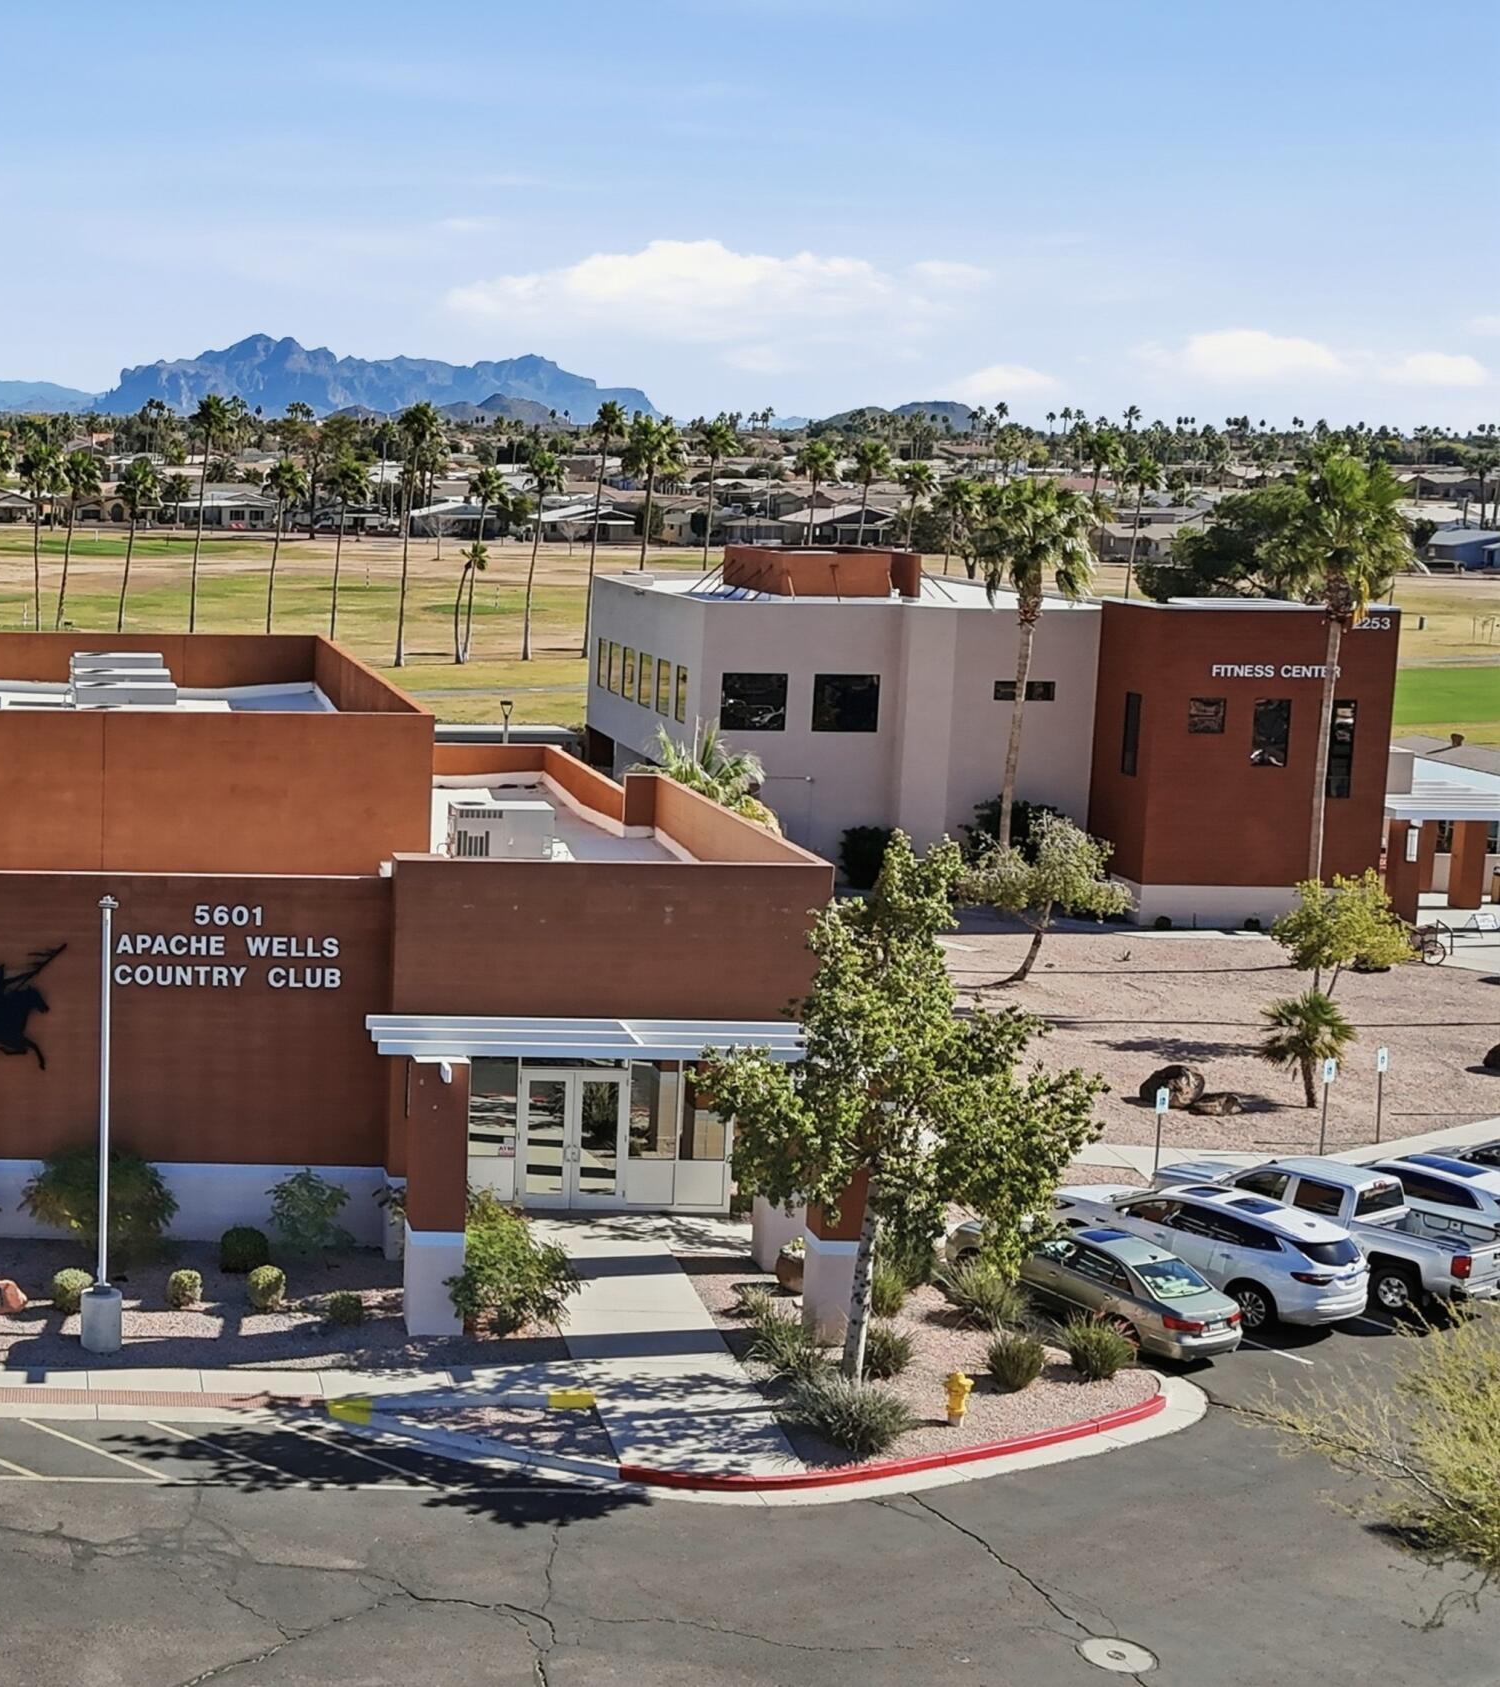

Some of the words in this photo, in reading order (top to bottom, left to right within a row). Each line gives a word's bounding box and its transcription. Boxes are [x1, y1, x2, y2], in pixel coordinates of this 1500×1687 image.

[1211, 664, 1275, 678] FITNESS
[194, 905, 263, 926] 5601
[116, 934, 225, 956] APACHE
[246, 936, 340, 958] WELLS
[113, 964, 247, 987] COUNTRY
[267, 966, 342, 988] CLUB
